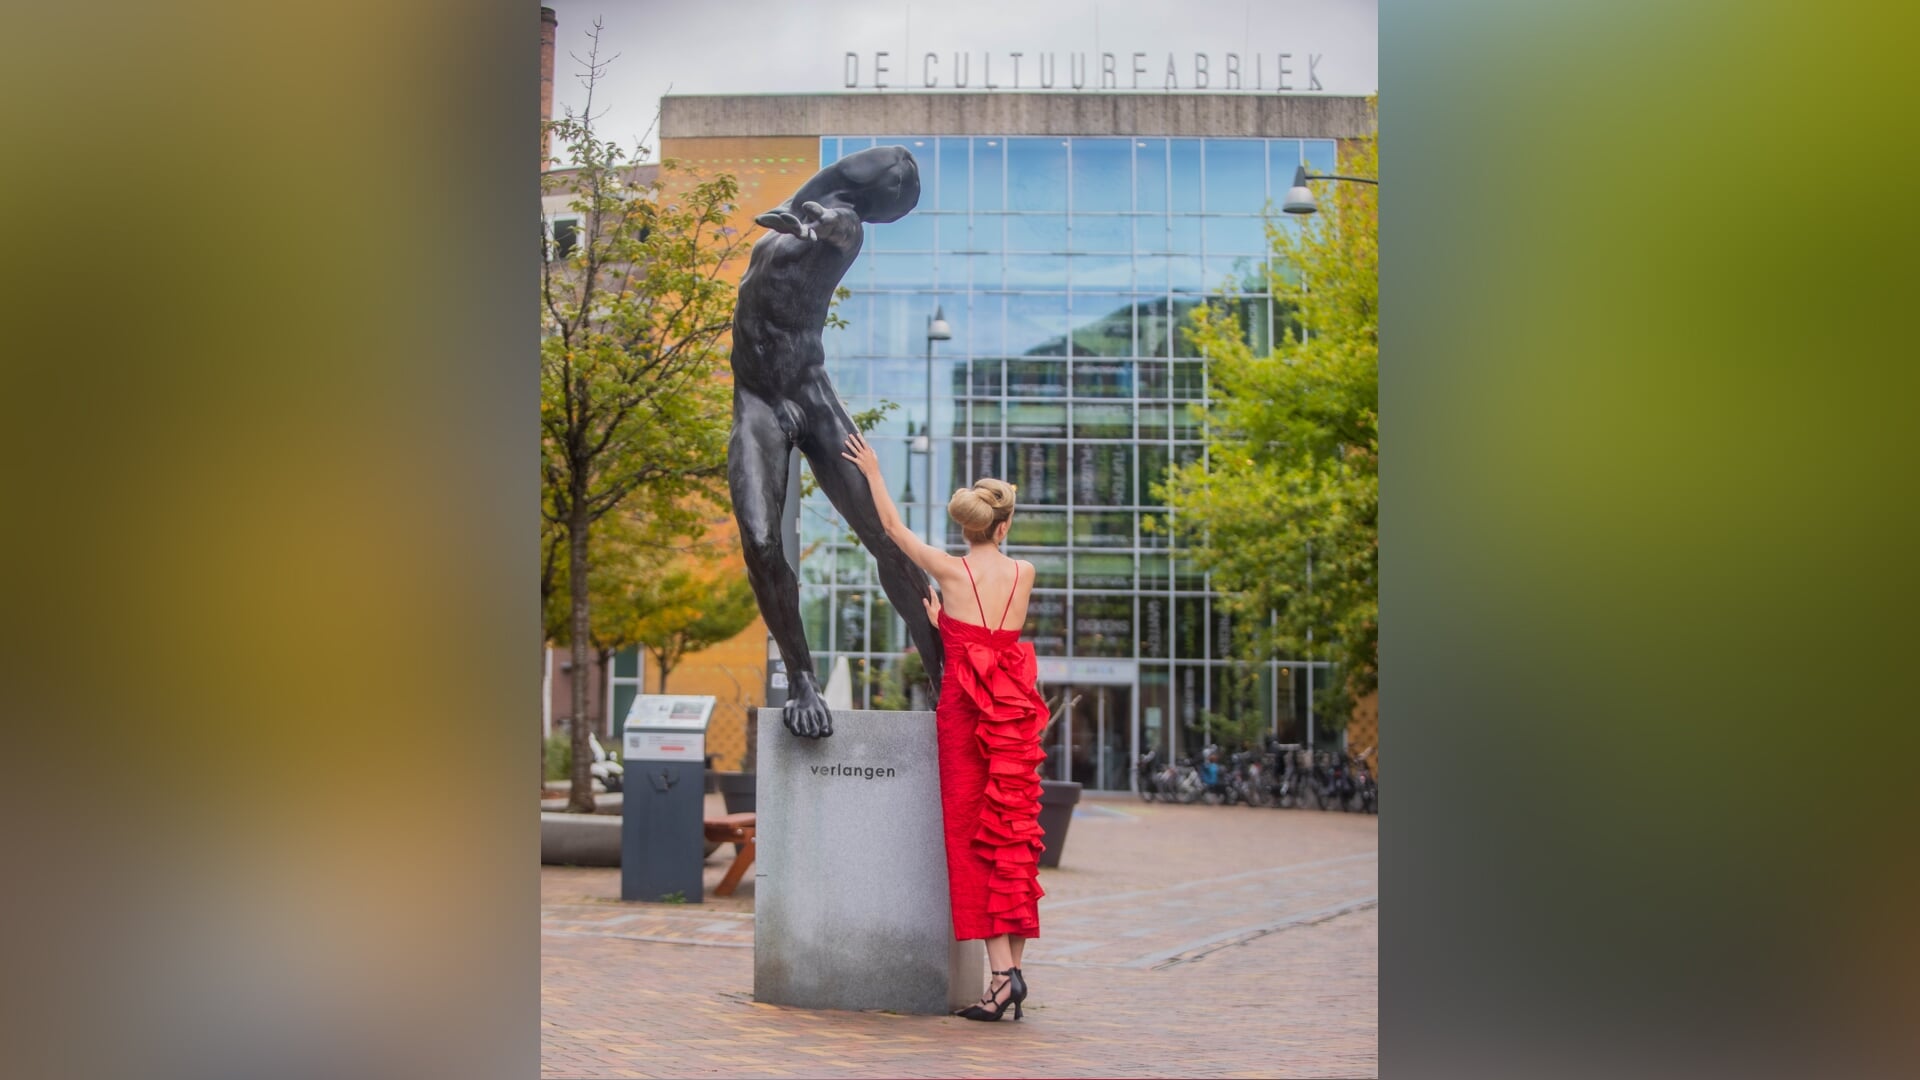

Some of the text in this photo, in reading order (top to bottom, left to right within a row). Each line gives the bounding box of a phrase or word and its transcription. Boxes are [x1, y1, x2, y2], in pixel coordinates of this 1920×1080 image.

[844, 52, 1324, 92] DE CULTUURFABRIEK
[810, 763, 895, 780] verlangen
